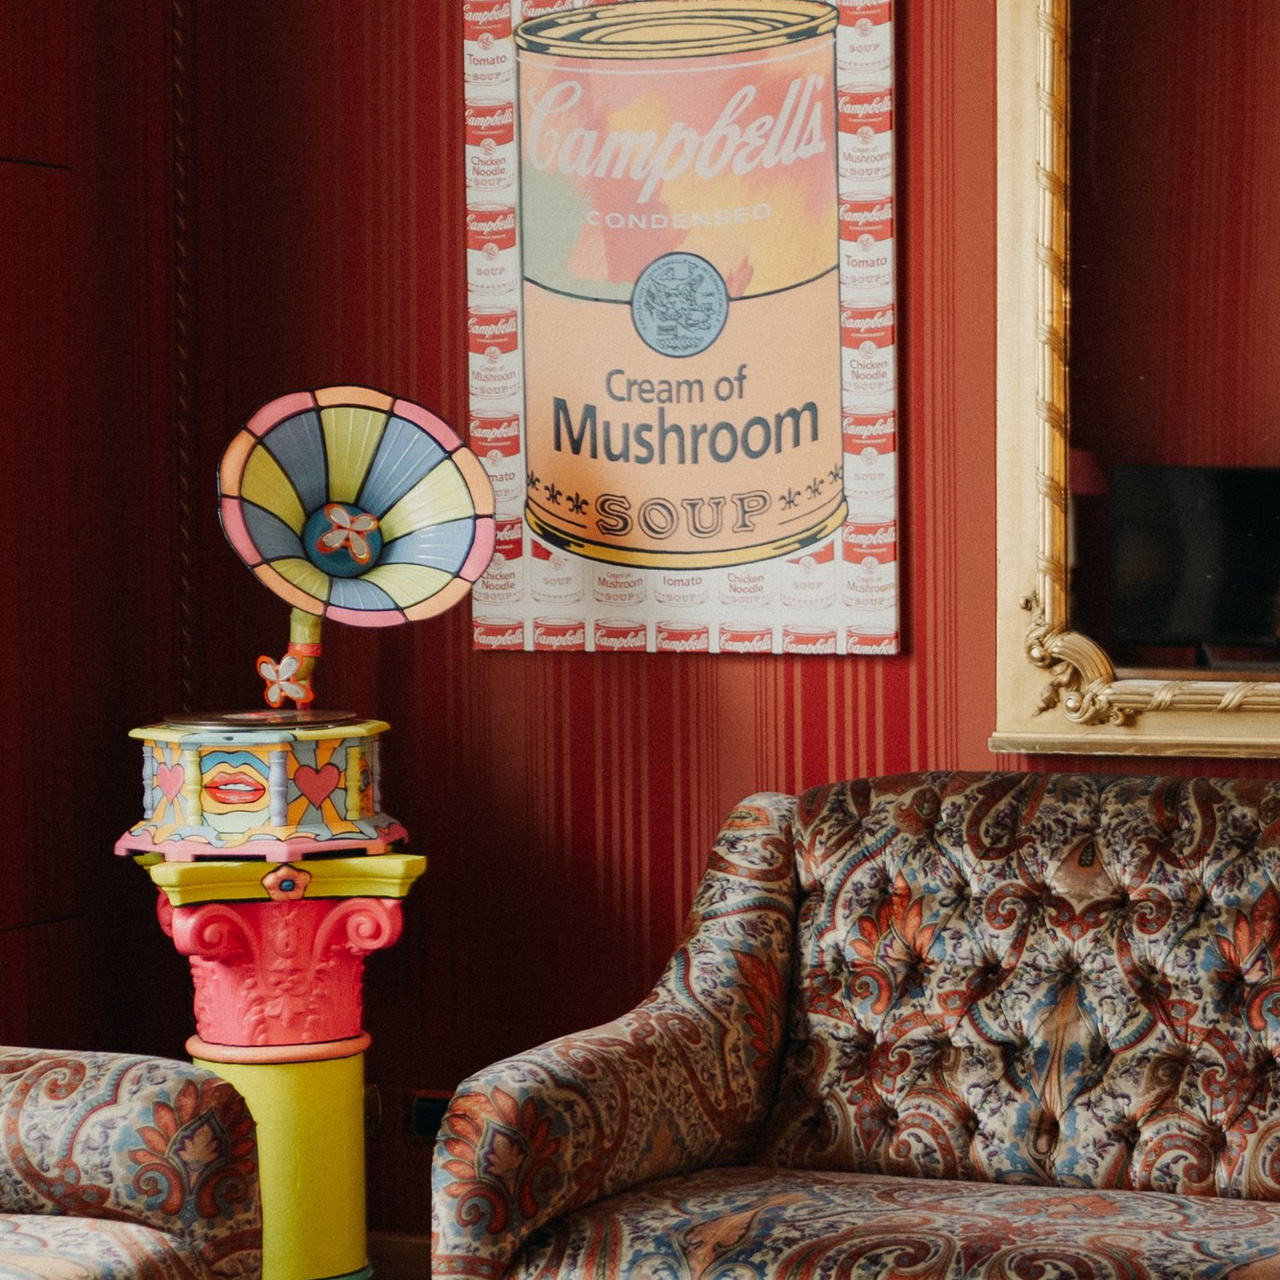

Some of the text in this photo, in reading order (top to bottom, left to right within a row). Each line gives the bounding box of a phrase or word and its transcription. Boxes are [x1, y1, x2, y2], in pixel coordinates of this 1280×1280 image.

[849, 44, 880, 53] SOUP
[467, 53, 506, 65] Tomato
[527, 74, 826, 203] Campbell's
[471, 156, 505, 166] Chicken
[843, 151, 890, 163] Mushroom
[472, 165, 505, 176] Noodle
[586, 203, 772, 229] CONDENSED
[845, 255, 887, 268] Tomato
[850, 360, 887, 370] Chicken
[472, 371, 516, 382] Mushroom
[852, 370, 887, 380] Noodle
[606, 364, 747, 404] Cream of
[553, 396, 819, 465] Mushroom
[489, 472, 515, 482] mato
[595, 489, 772, 540] SOUP
[598, 577, 643, 589] Mushroom
[728, 573, 764, 583] Chicken
[482, 580, 515, 590] Noodle
[729, 583, 764, 593] Noodle
